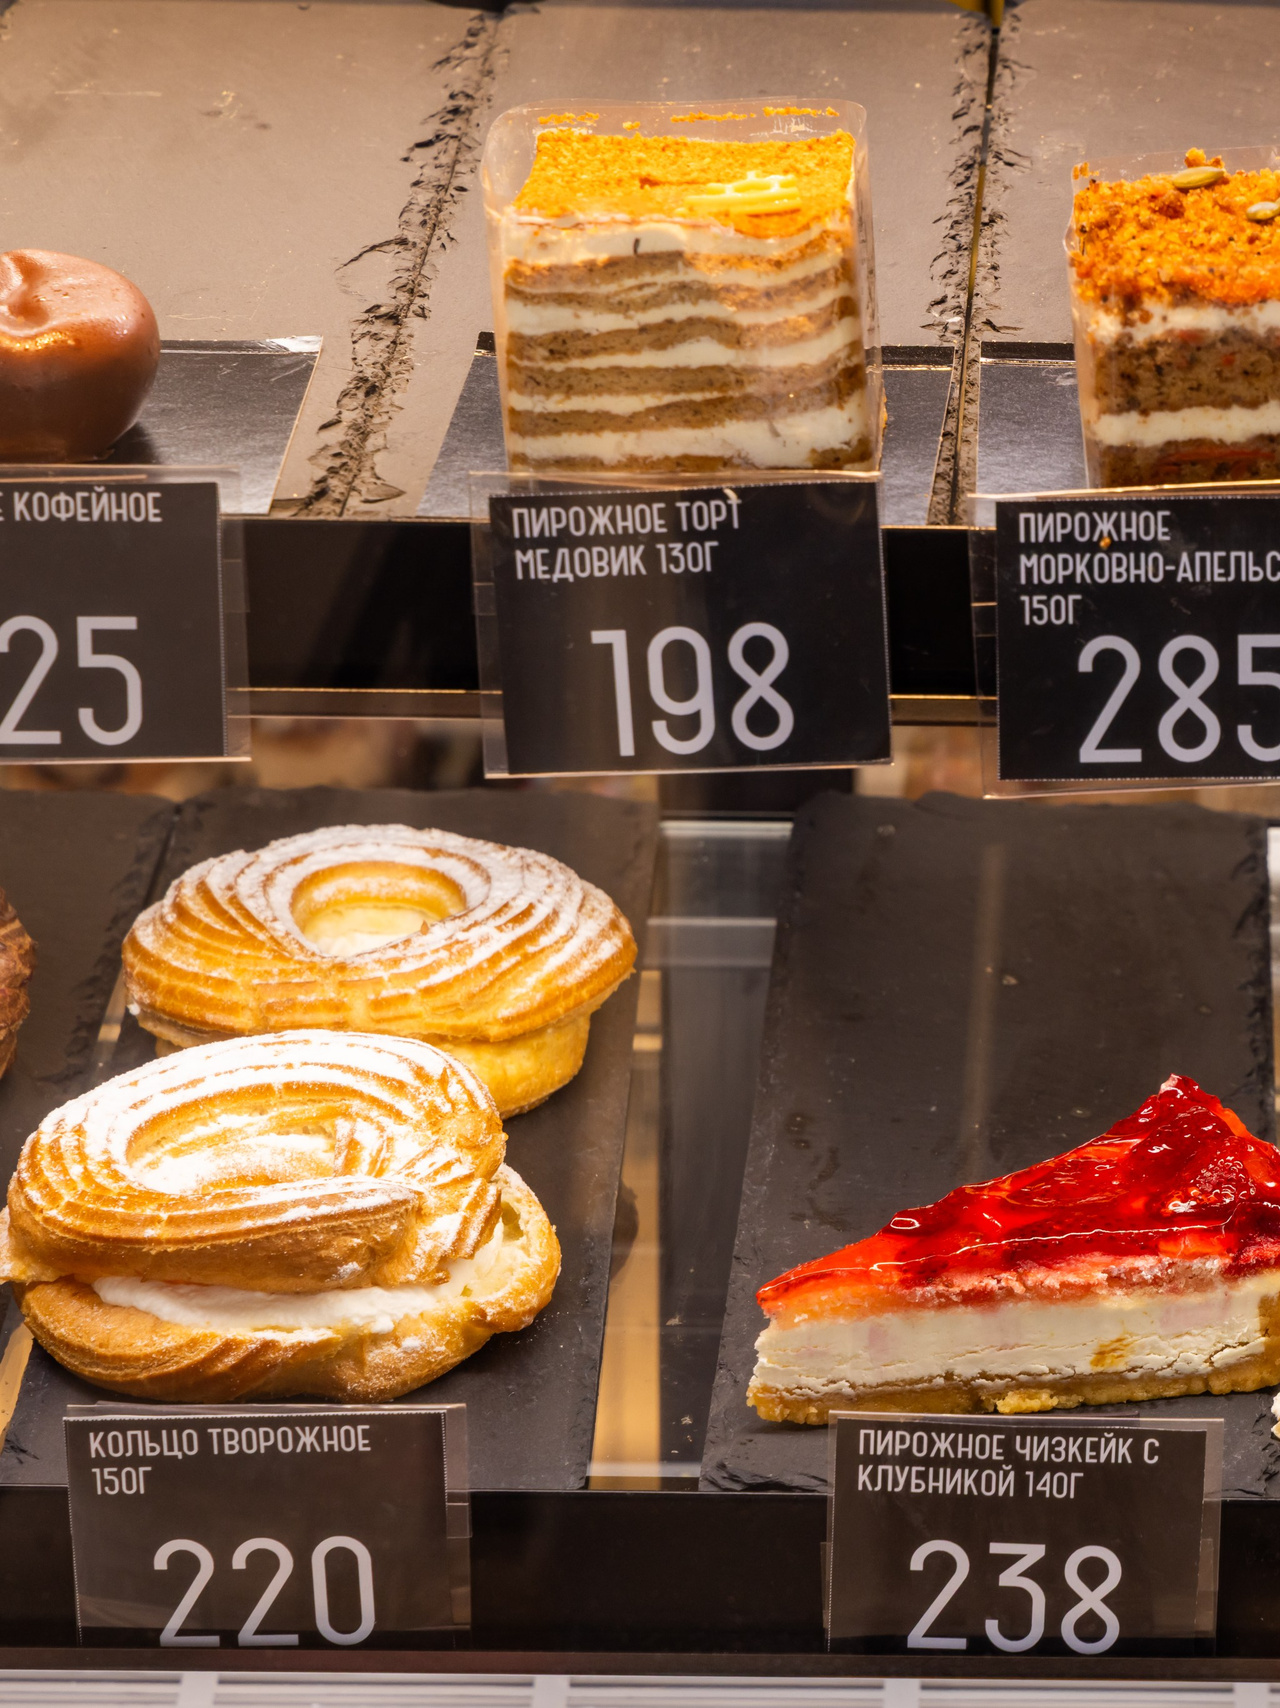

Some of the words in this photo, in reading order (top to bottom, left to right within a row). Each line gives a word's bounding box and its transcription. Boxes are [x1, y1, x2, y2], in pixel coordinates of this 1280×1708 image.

[13, 486, 163, 522] КОФЕЙНОЕ
[511, 503, 668, 538] ПИРОЖНОЕ
[675, 500, 742, 531] ТОРТ
[1018, 510, 1172, 544] ПИРОЖНОЕ
[514, 545, 647, 583] МЕДОВИК
[655, 540, 719, 575] 130Г
[1019, 594, 1083, 626] 150Г
[590, 621, 795, 757] 198
[88, 1427, 199, 1459] КОЛЬЦО
[207, 1424, 372, 1456] ТВОРОЖНОЕ
[858, 1429, 1006, 1461] ПИРОЖНОЕ
[1015, 1432, 1133, 1464] ЧИЗКЕЙК
[1143, 1438, 1160, 1465] С
[91, 1466, 152, 1495] 150Г
[857, 1464, 1015, 1498] КЛУБНИКОЙ
[1025, 1470, 1084, 1499] 140Г
[153, 1535, 376, 1647] 220
[906, 1539, 1123, 1656] 238
